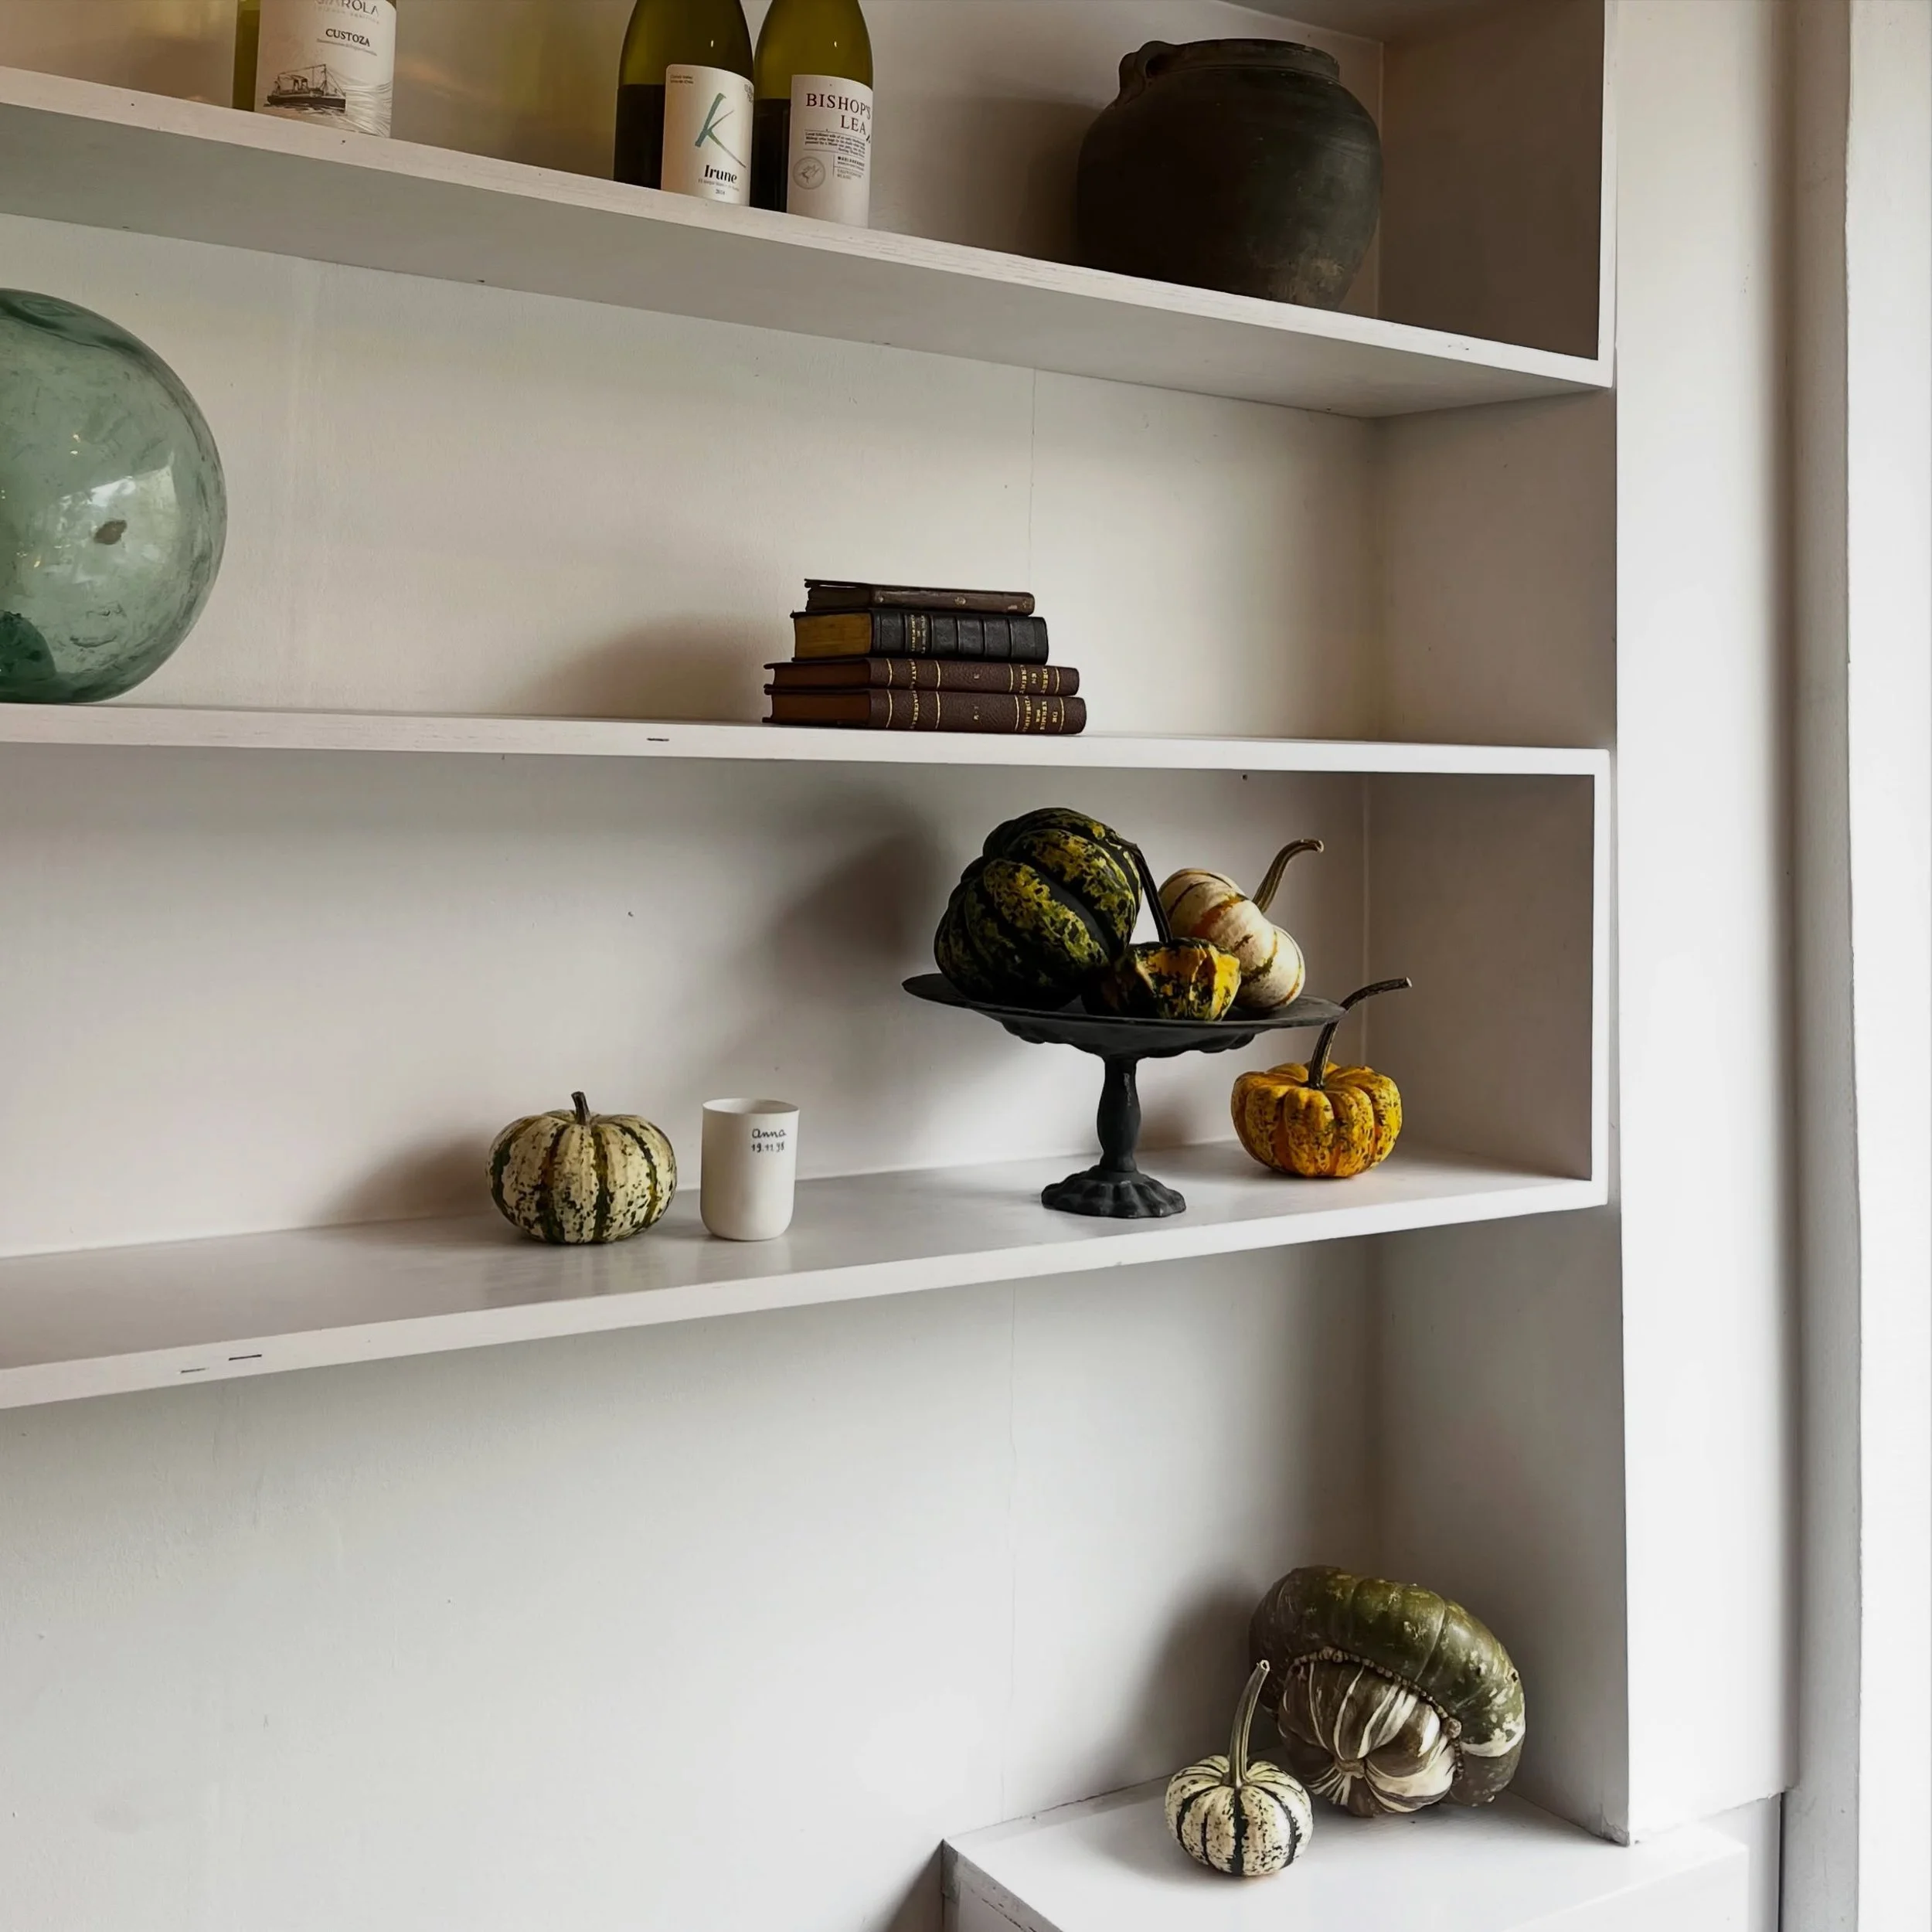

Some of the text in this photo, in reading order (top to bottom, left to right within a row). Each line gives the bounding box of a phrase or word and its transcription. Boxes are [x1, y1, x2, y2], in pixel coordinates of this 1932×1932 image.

[325, 28, 370, 47] CUSTOZA
[806, 93, 871, 120] BISHOP'S
[704, 165, 737, 183] Irune
